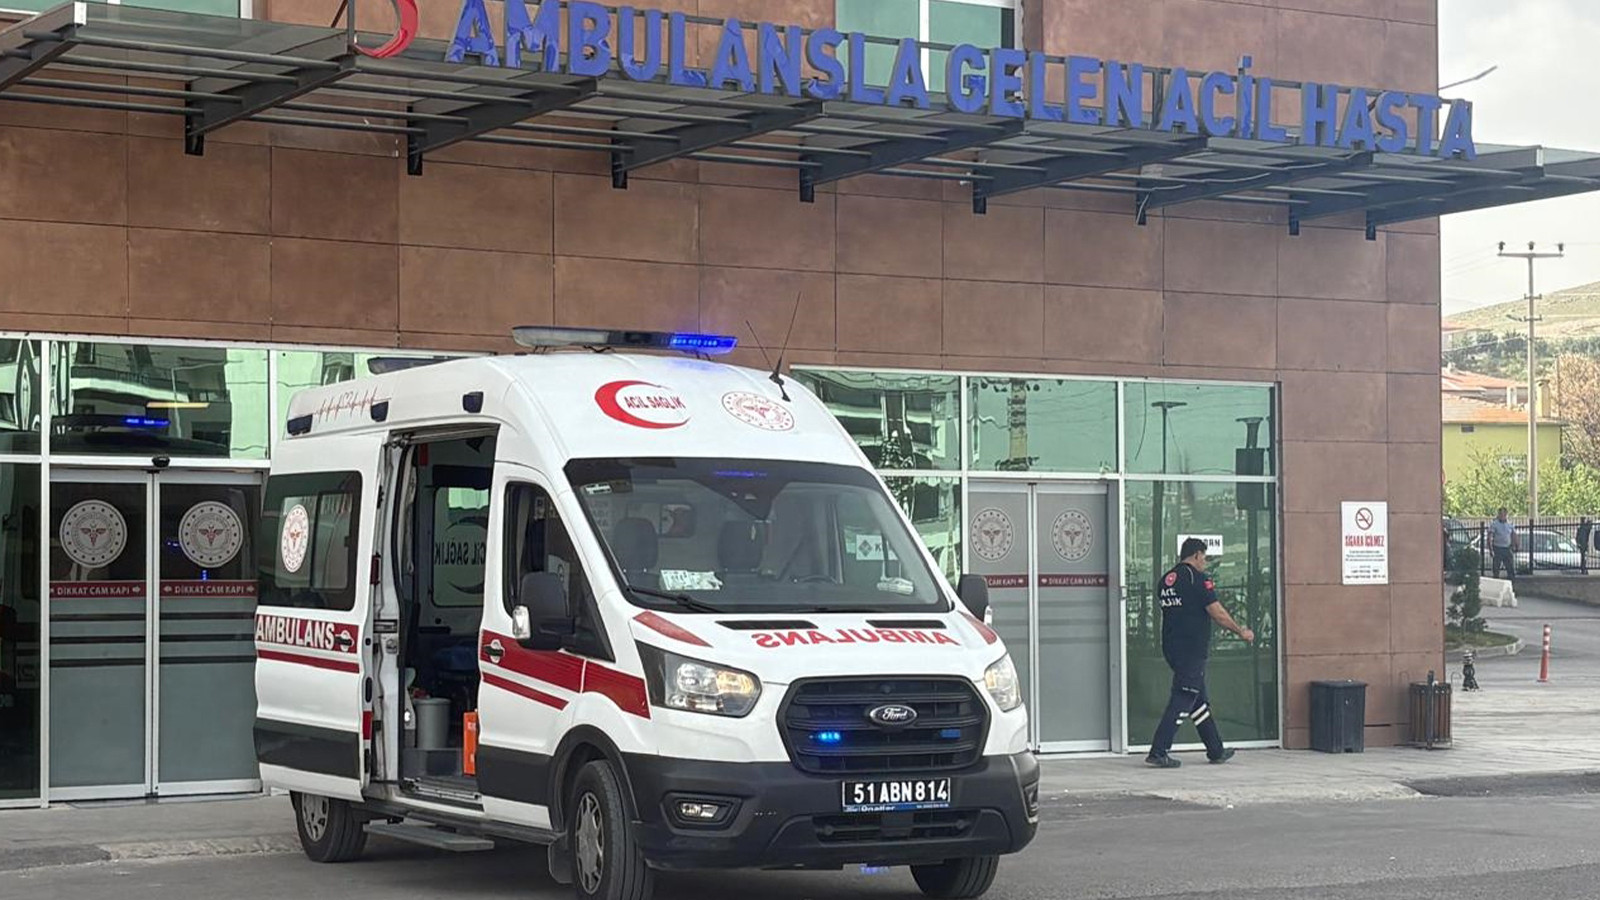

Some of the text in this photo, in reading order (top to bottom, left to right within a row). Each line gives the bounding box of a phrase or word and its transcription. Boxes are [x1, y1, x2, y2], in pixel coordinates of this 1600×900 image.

[443, 0, 1477, 160] AMBULANSLA GELEN ACİL HASTA
[57, 586, 130, 596] DİKKAT CAM KAPI
[174, 586, 244, 595] DİKKAT CAM KAPI
[254, 614, 335, 650] AMBULANS
[854, 780, 948, 803] 51 ABN 814
